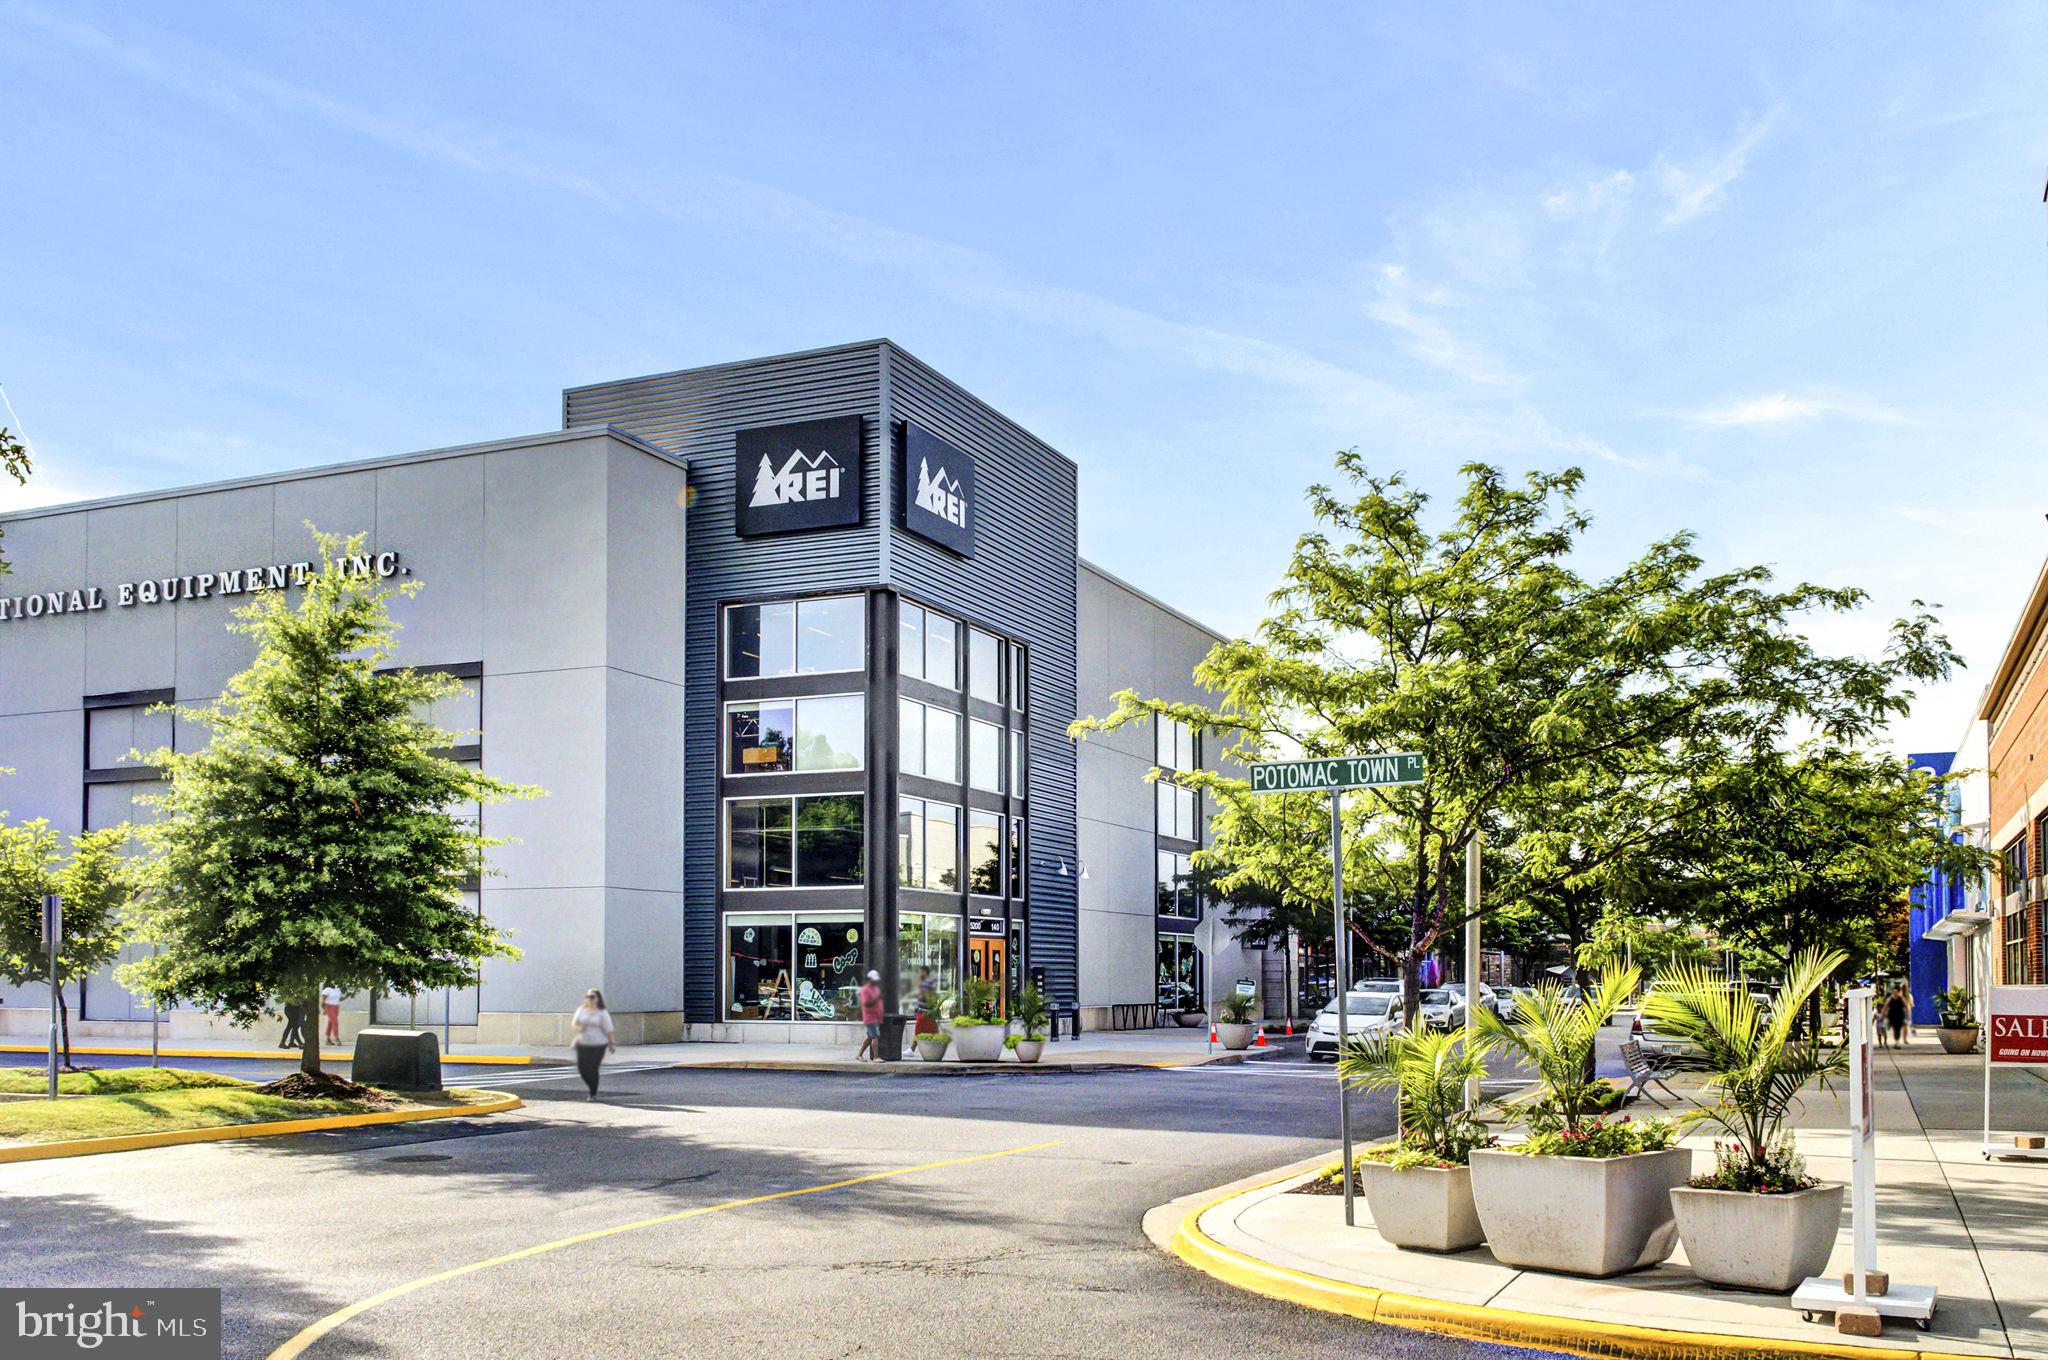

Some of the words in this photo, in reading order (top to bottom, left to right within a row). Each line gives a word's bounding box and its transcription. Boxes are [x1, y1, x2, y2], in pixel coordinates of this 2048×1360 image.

[780, 468, 840, 502] REI
[0, 587, 104, 621] TIONAL
[336, 551, 412, 581] INC.
[1253, 761, 1339, 790] POTOMAC
[1346, 757, 1399, 784] TOWN
[1407, 755, 1420, 769] PL
[1998, 1048, 2020, 1056] GOING
[2020, 1048, 2031, 1057] ON
